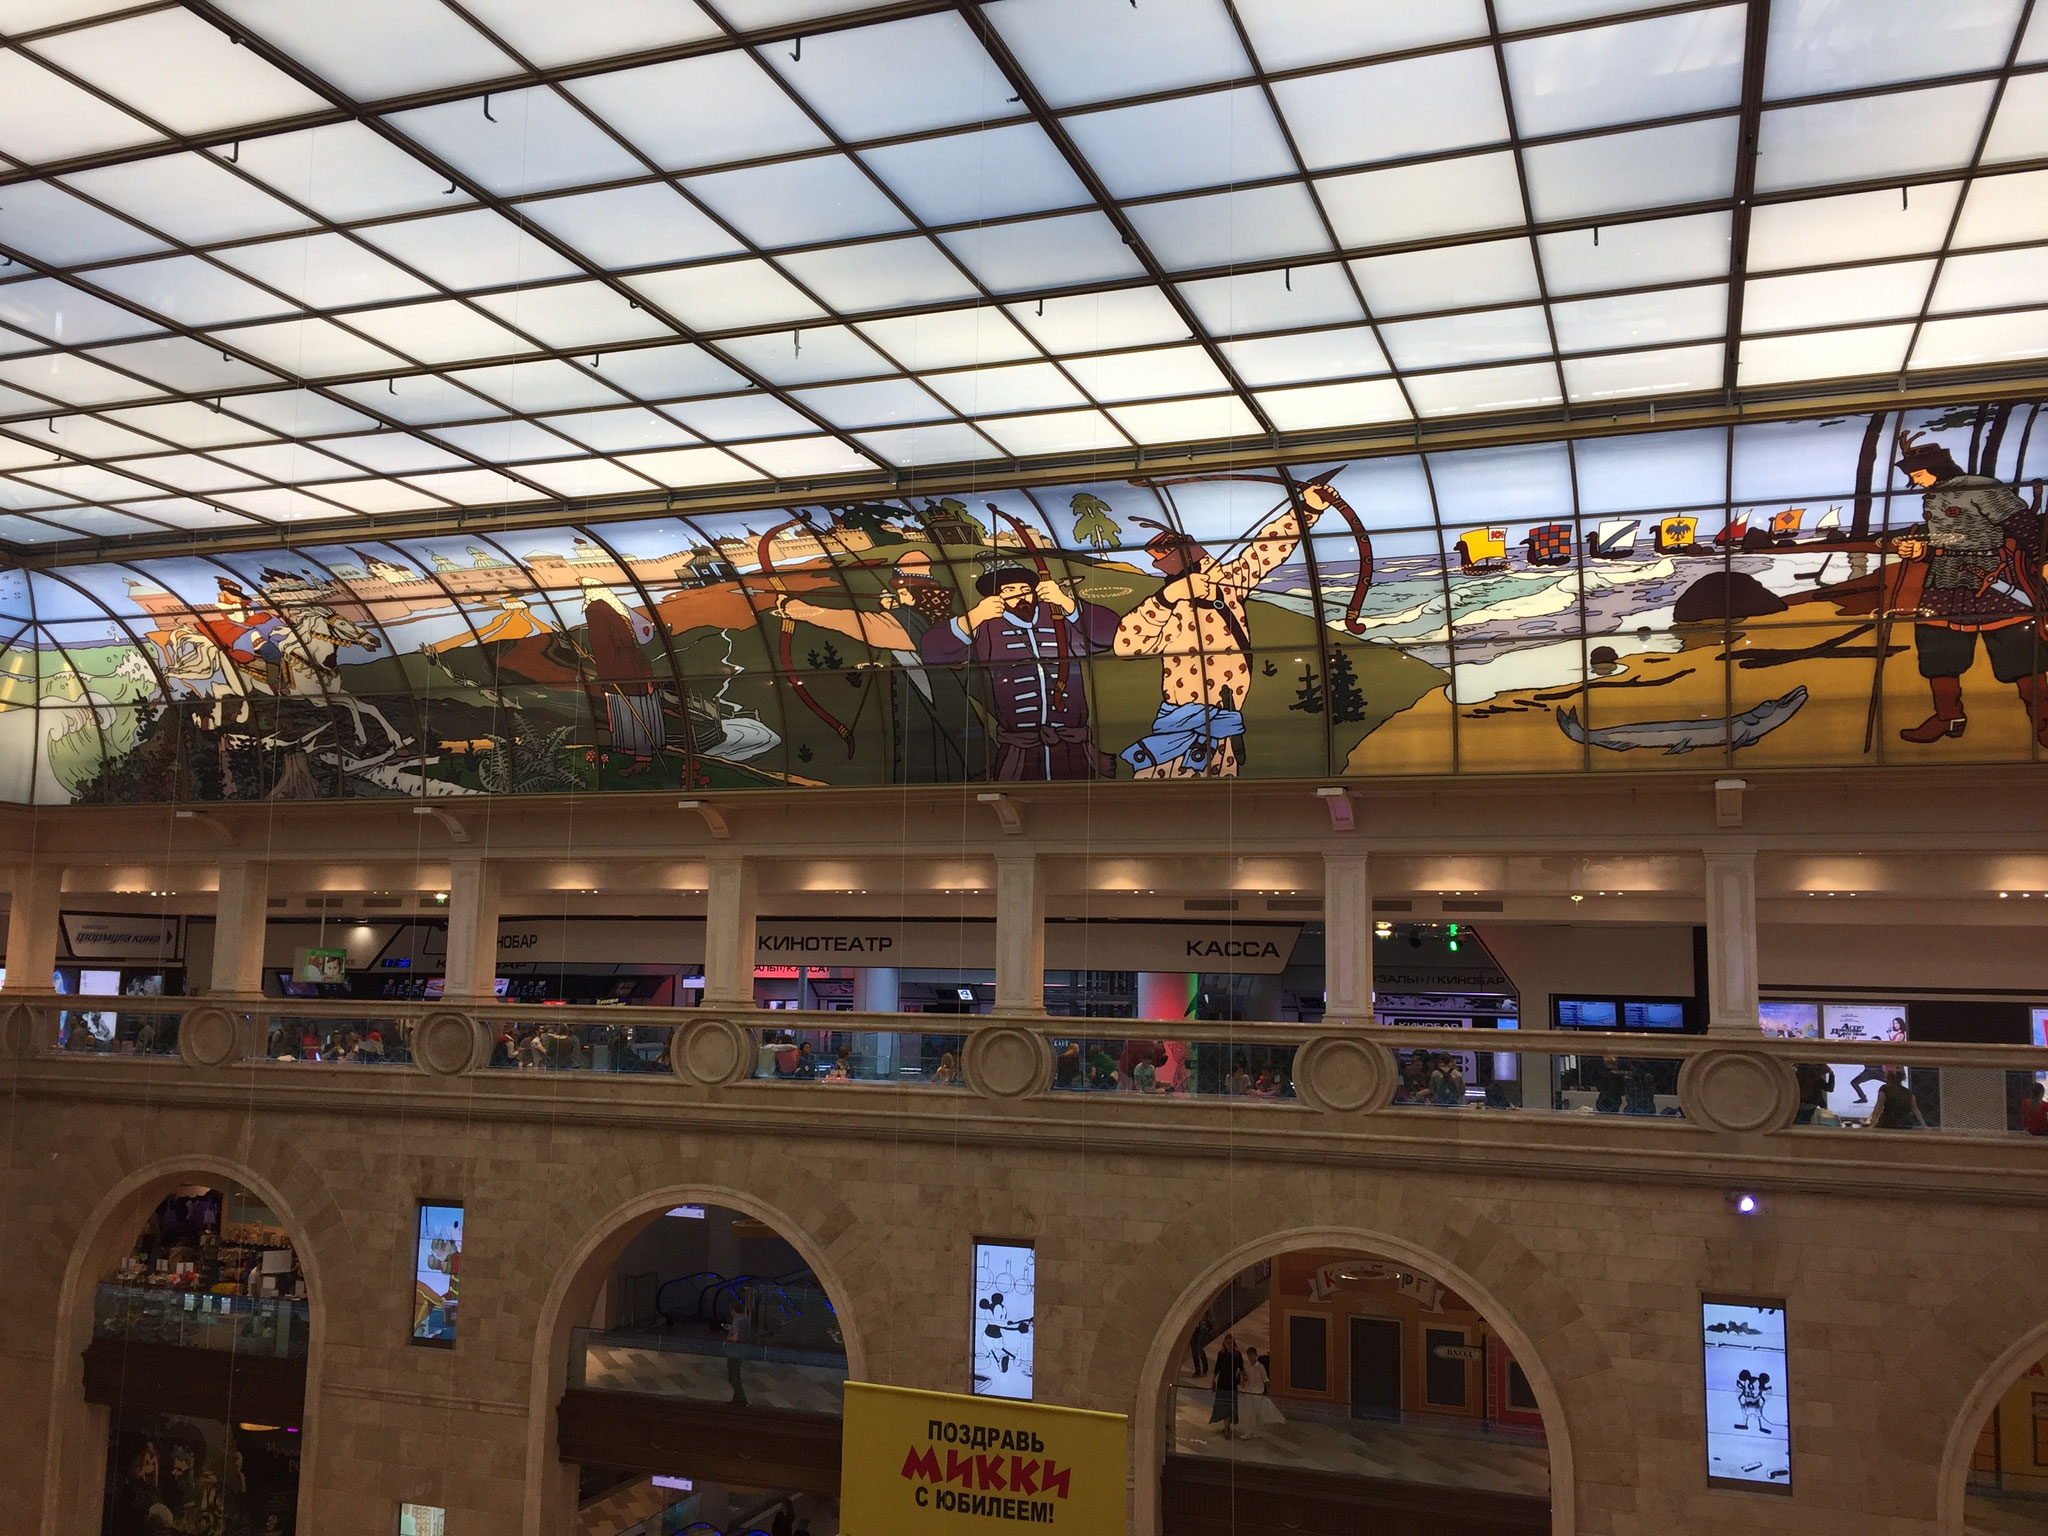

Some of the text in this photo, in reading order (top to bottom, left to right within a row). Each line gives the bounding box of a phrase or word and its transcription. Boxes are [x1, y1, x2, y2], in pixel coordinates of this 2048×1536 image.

[758, 935, 893, 952] КИНОТЕАТР
[1186, 940, 1280, 958] КАССА
[928, 1420, 1045, 1453] ПОЗДРАВЬ
[901, 1445, 1071, 1500] МИККИ
[915, 1486, 1054, 1524] С ЮБИЛЕЕМ!
